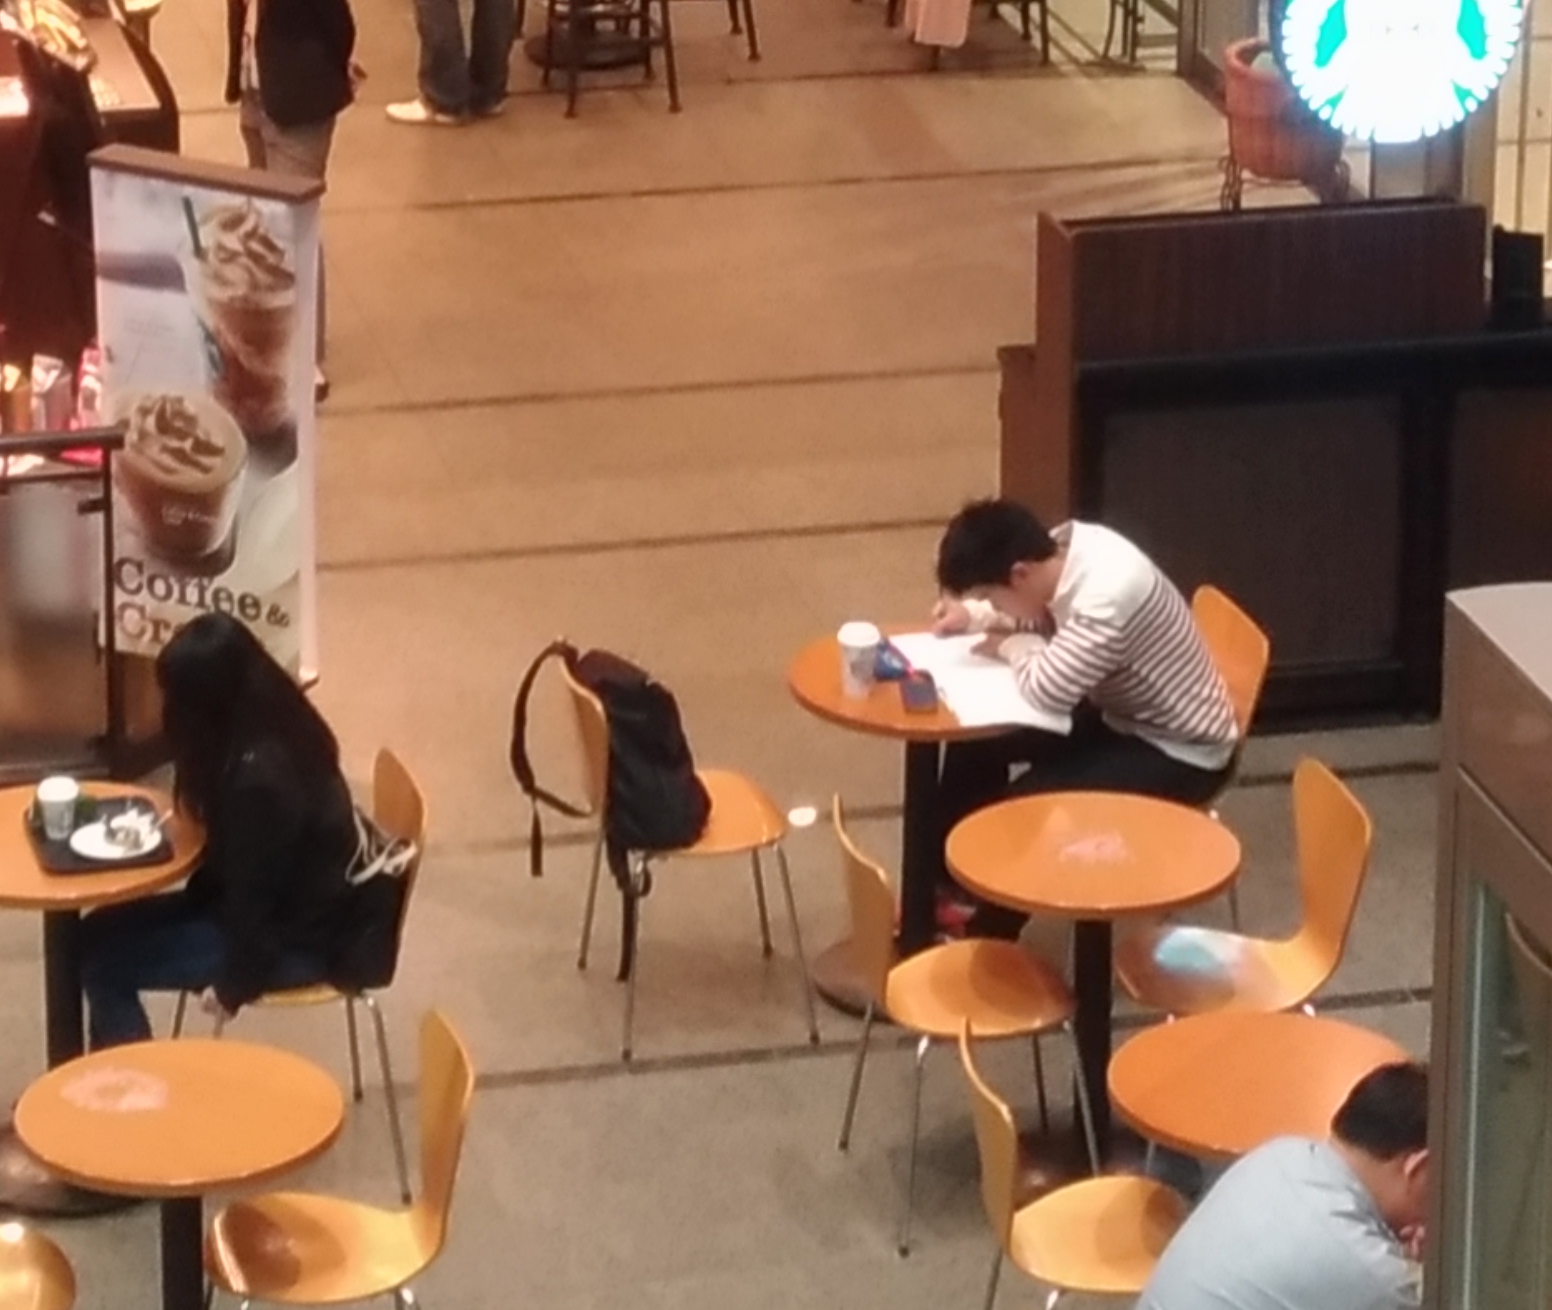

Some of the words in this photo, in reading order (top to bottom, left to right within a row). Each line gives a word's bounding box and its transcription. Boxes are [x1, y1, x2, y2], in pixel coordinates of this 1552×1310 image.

[115, 557, 261, 622] Coffee
[266, 602, 291, 629] &
[117, 602, 186, 645] Cr
